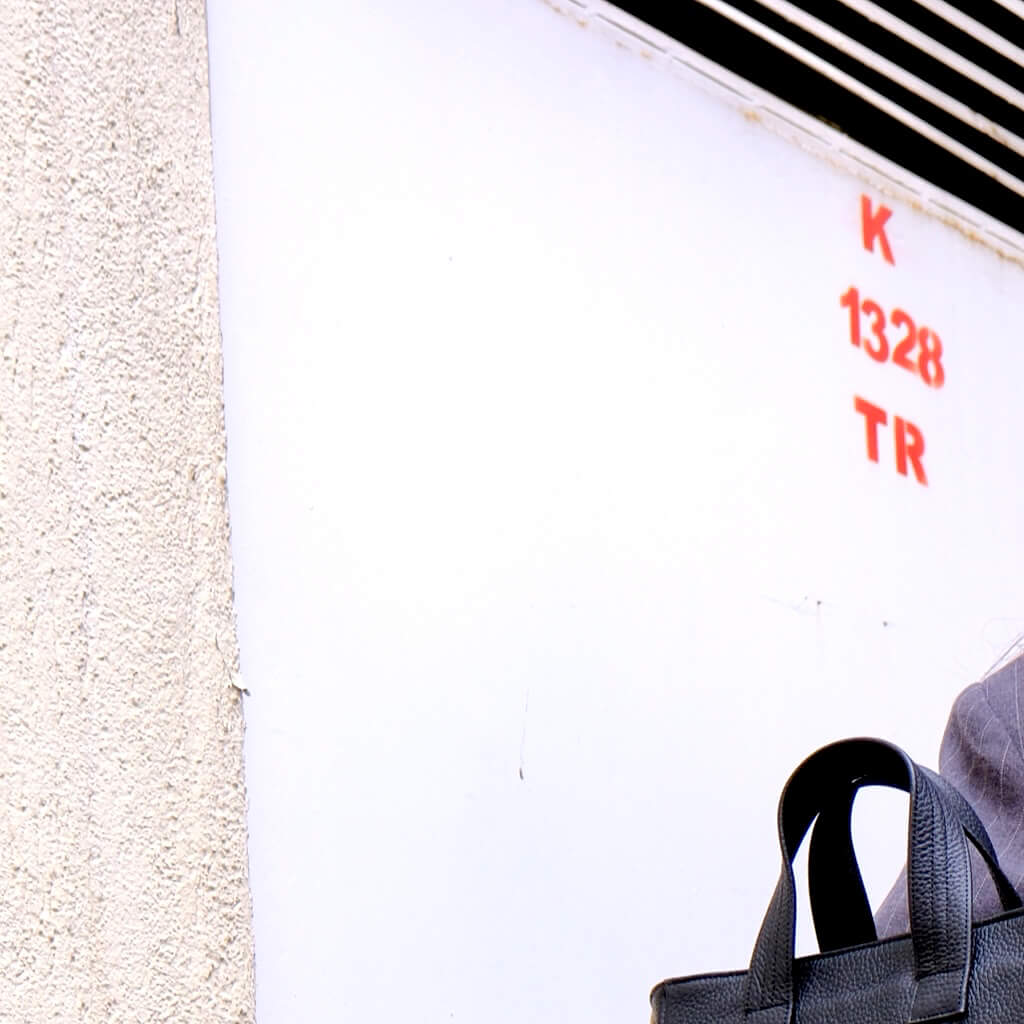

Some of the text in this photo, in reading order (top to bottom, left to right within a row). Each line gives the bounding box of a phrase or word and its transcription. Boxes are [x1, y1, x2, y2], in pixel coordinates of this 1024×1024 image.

[859, 192, 896, 266] K
[839, 286, 945, 389] 1328
[853, 395, 929, 487] TR
